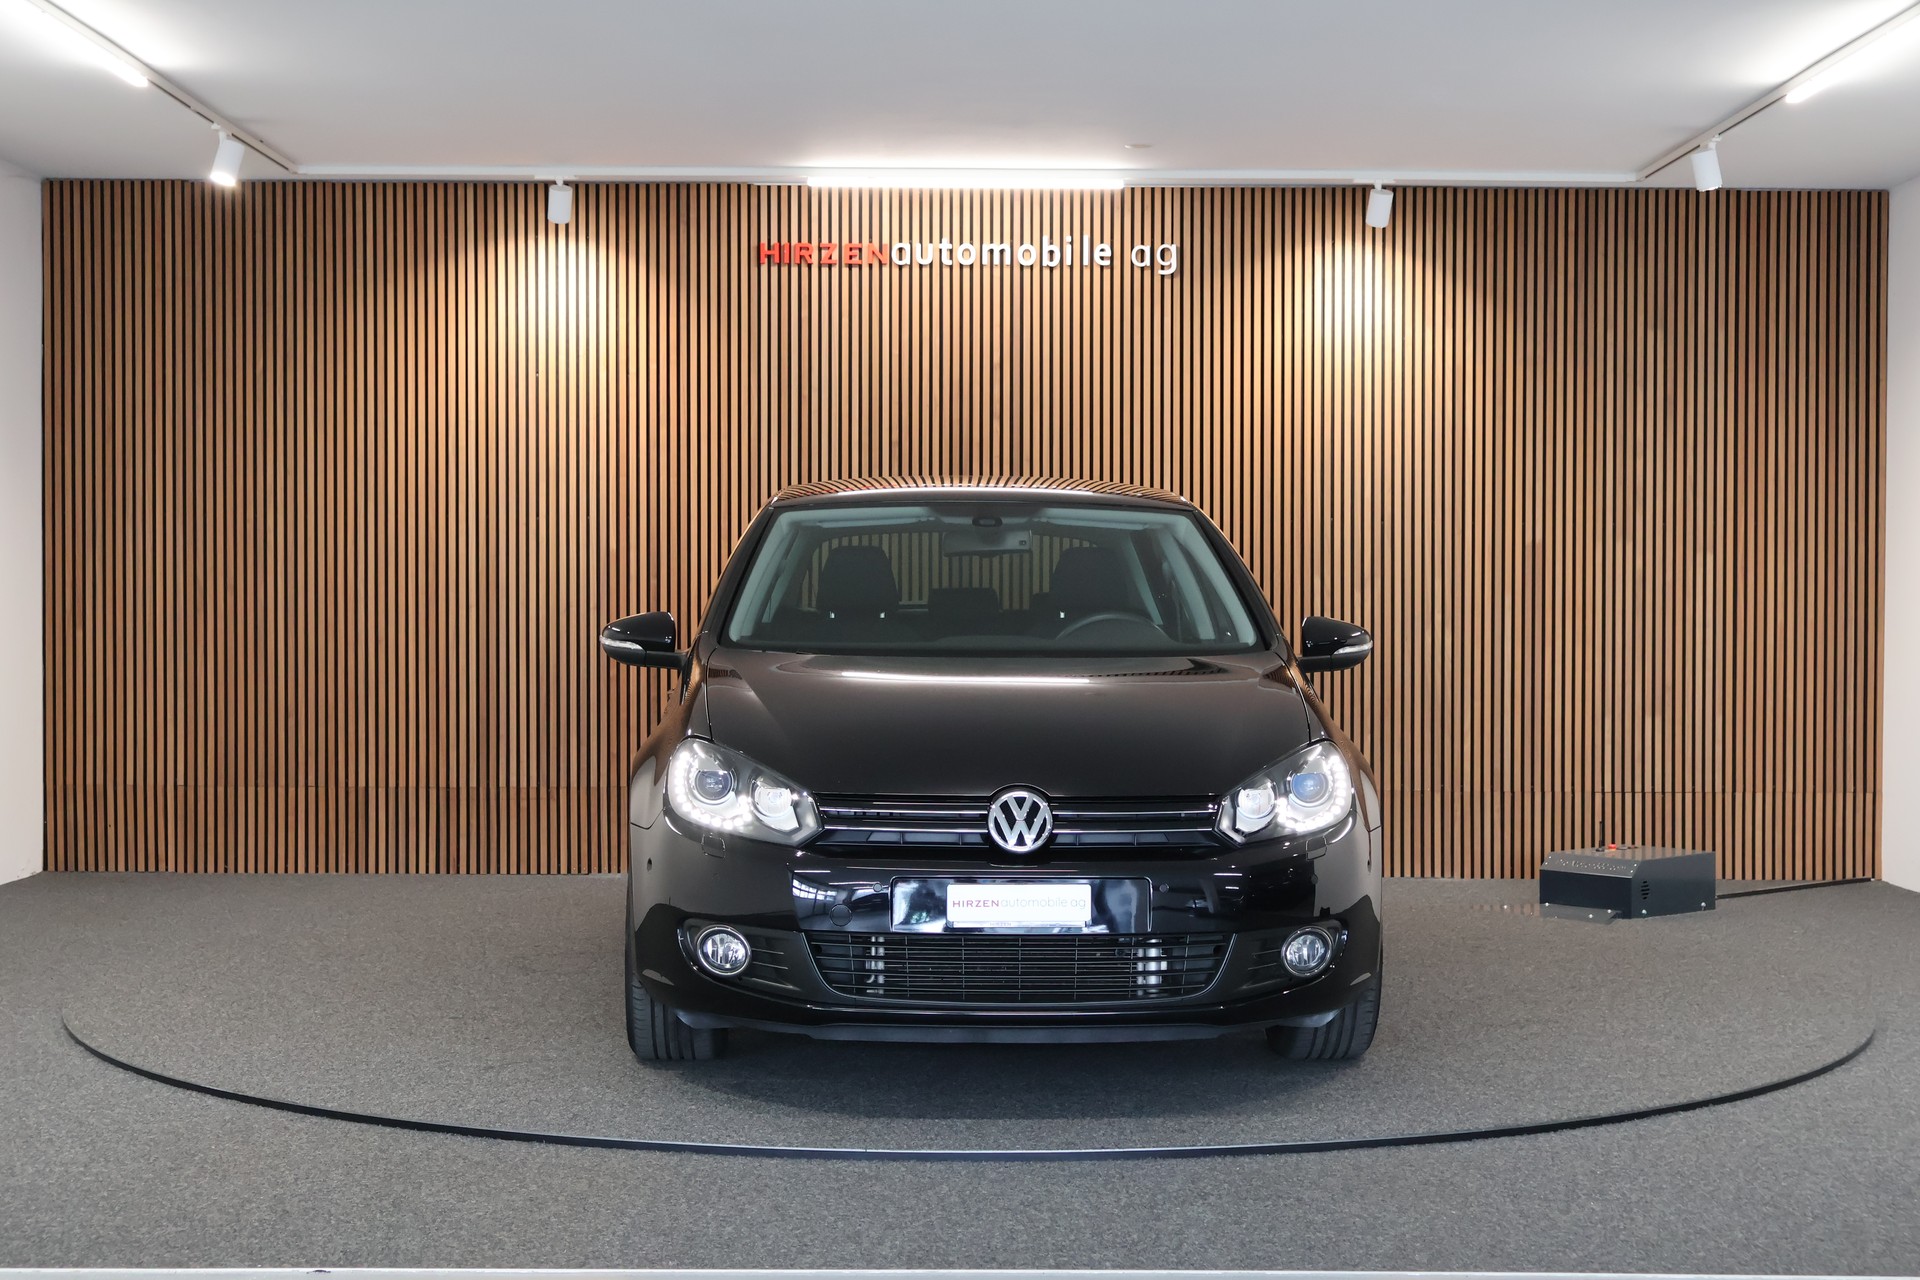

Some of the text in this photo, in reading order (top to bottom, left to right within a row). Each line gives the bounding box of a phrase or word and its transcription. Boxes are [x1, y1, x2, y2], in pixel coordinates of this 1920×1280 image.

[1131, 243, 1178, 275] ag
[989, 792, 1052, 851] VW
[1070, 899, 1086, 910] ag
